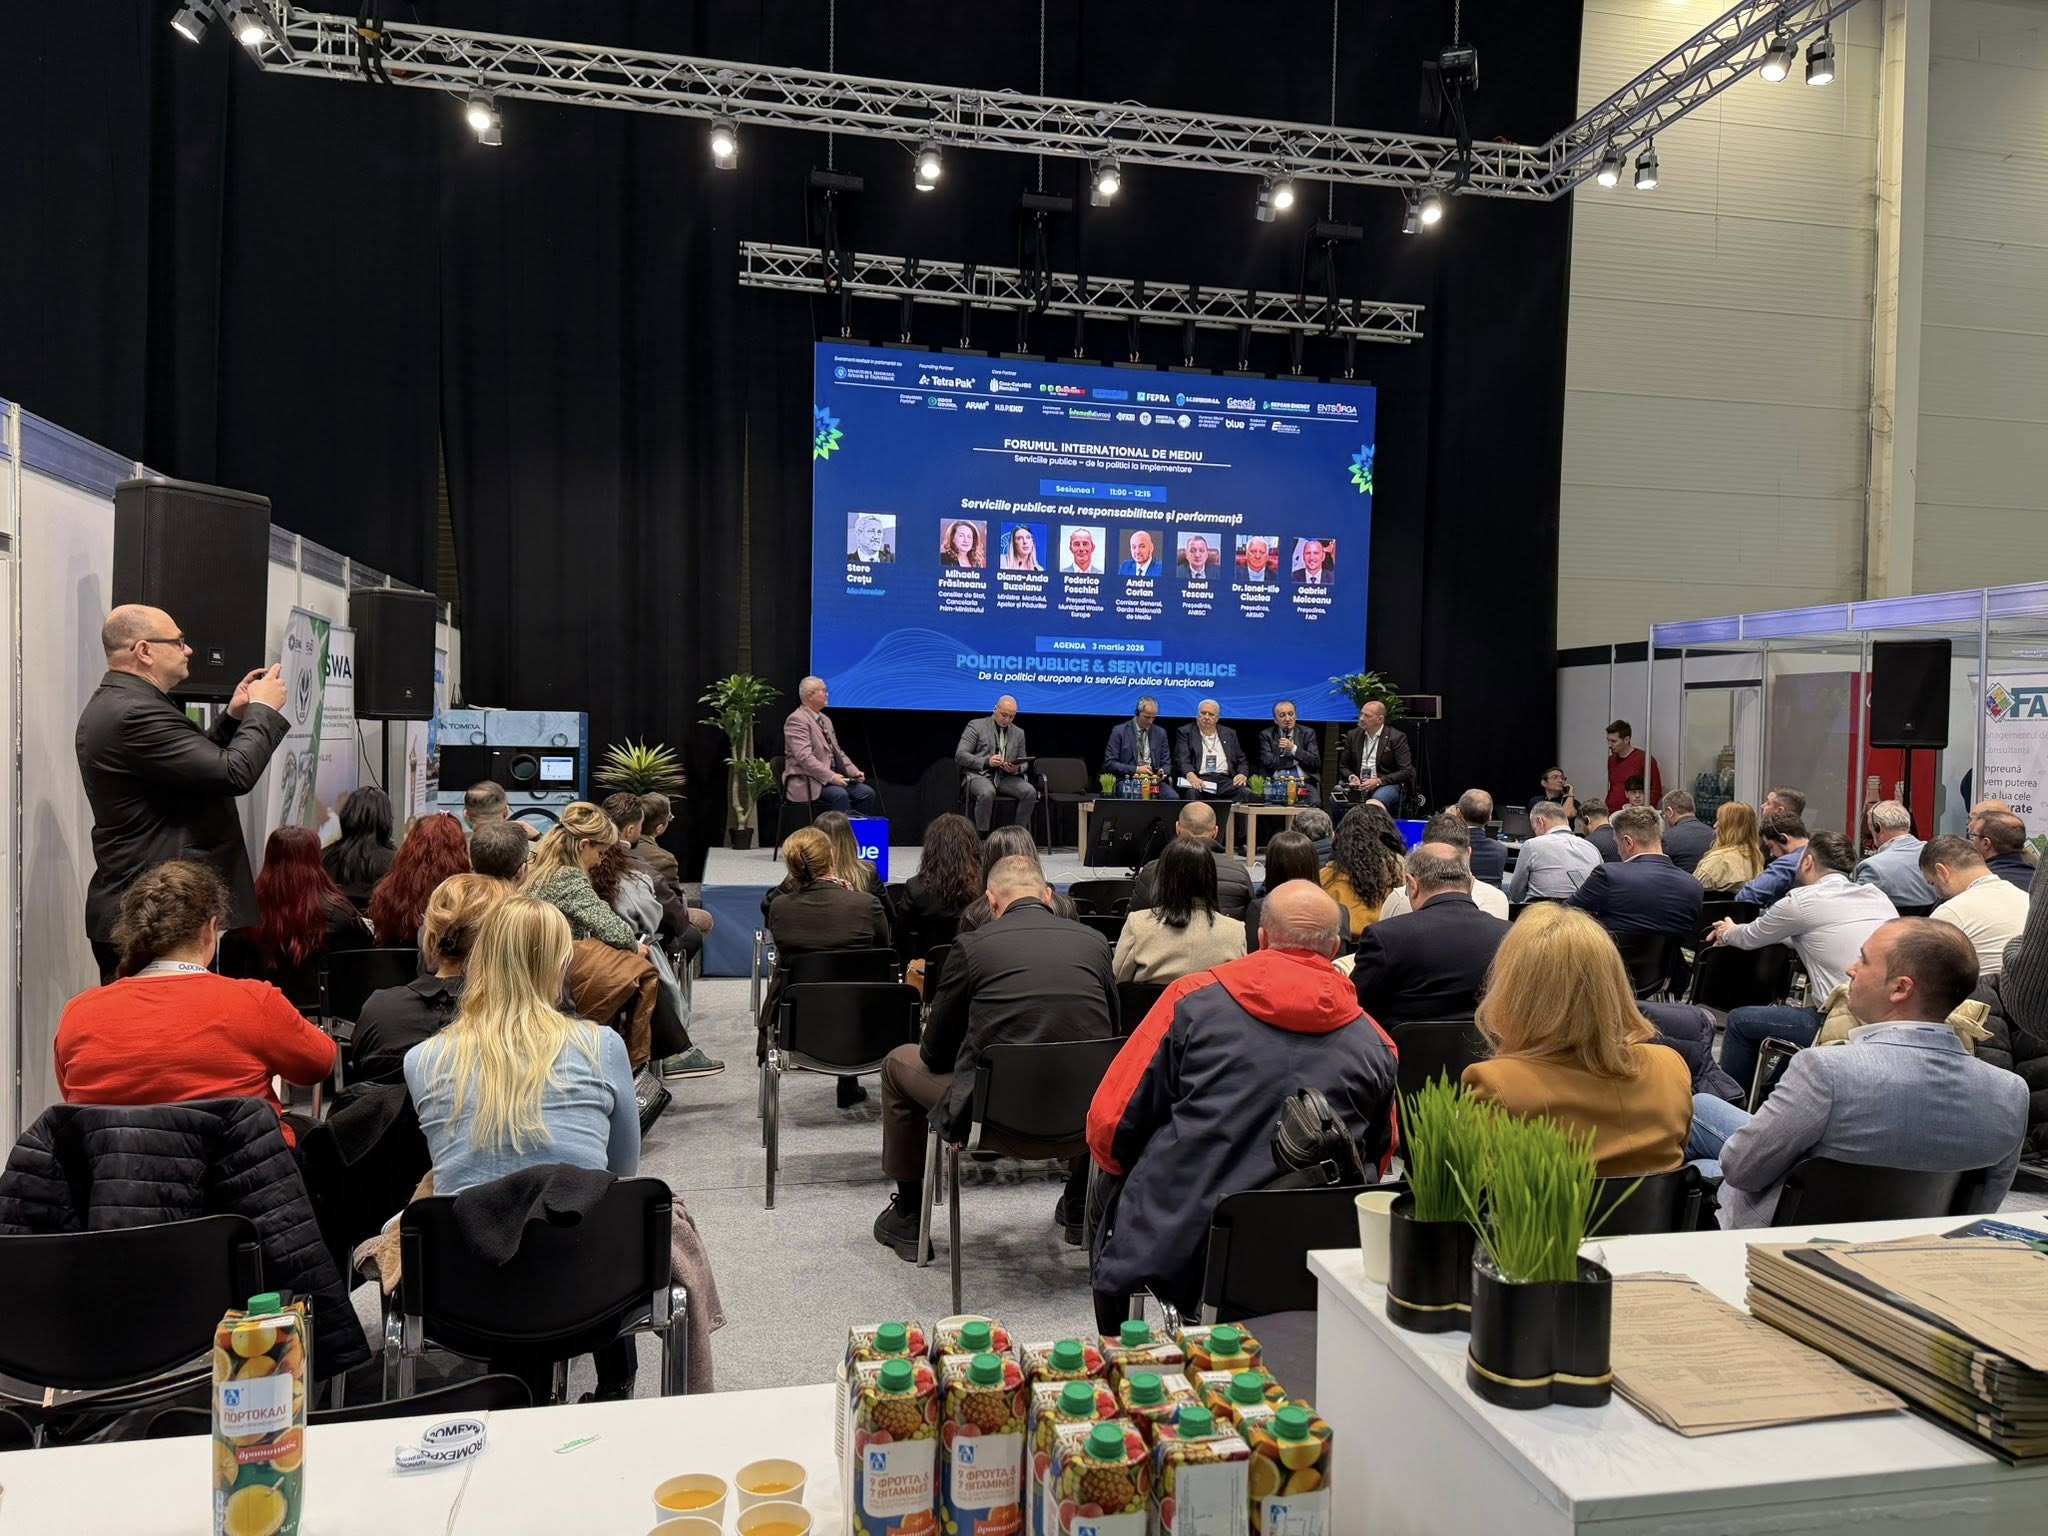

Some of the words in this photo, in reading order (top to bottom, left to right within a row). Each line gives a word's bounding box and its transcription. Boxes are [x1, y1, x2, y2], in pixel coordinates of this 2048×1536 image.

[932, 376, 954, 386] Tetra
[1146, 394, 1170, 402] FEPRA
[965, 401, 986, 410] ARAM
[1225, 419, 1245, 429] blue
[1004, 439, 1058, 452] FORUMUL
[1062, 443, 1149, 458] INTERNAȚIONAL
[1152, 449, 1166, 458] DE
[1169, 450, 1202, 461] MEDIU
[1015, 454, 1047, 464] Serviciile
[1049, 457, 1077, 466] publice
[1140, 463, 1192, 473] implementare
[1056, 485, 1090, 494] Sesiunea
[1110, 488, 1127, 496] 11:00
[1135, 489, 1151, 497] 12:15
[961, 498, 1011, 510] Serviciile
[1012, 502, 1056, 514] publice:
[1058, 504, 1075, 516] rol,
[1077, 506, 1164, 520] responsabilitate
[1166, 510, 1176, 522] și
[1176, 511, 1243, 526] performanță
[847, 564, 870, 573] Stere
[946, 570, 980, 579] Mihaela
[997, 572, 1048, 582] Diana-Anda
[847, 574, 872, 586] Crețu
[939, 579, 986, 589] Frăsineanu
[1064, 576, 1100, 585] Federico
[1126, 579, 1154, 588] Andrei
[1188, 581, 1208, 589] Ionel
[1003, 582, 1042, 591] Buzoianu
[1064, 585, 1098, 594] Foschini
[1232, 584, 1243, 592] Dr.
[1245, 584, 1280, 594] Ionel-Ilie
[1298, 586, 1327, 595] Gabriel
[1182, 590, 1214, 599] Tescaru
[1053, 642, 1086, 650] AGENDA
[1092, 642, 1097, 650] 3
[1098, 643, 1125, 651] martie
[957, 654, 1022, 670] POLITICI
[1026, 656, 1089, 672] PUBLICE
[1092, 659, 1105, 672] &
[1108, 660, 1172, 675] SERVICII
[1175, 662, 1236, 677] PUBLICE
[978, 672, 991, 680] De
[994, 672, 1002, 680] la
[1005, 672, 1035, 683] politici
[1038, 674, 1082, 684] europene
[1084, 675, 1094, 683] la
[1095, 675, 1127, 685] servicii
[1128, 677, 1162, 687] publice
[1164, 677, 1214, 688] funcționale
[2005, 778, 2037, 788] puterea
[2000, 790, 2012, 800] lua
[2014, 791, 2031, 800] cele
[2008, 804, 2032, 814] rate
[224, 1404, 286, 1423] ΠΟΡΤΟΚΑΛΙ
[421, 1438, 483, 1460] ROMEXPO
[967, 1468, 1009, 1480] ΦΡΟΥΤΑ
[878, 1474, 921, 1488] ΦΡΟΥΤΑ
